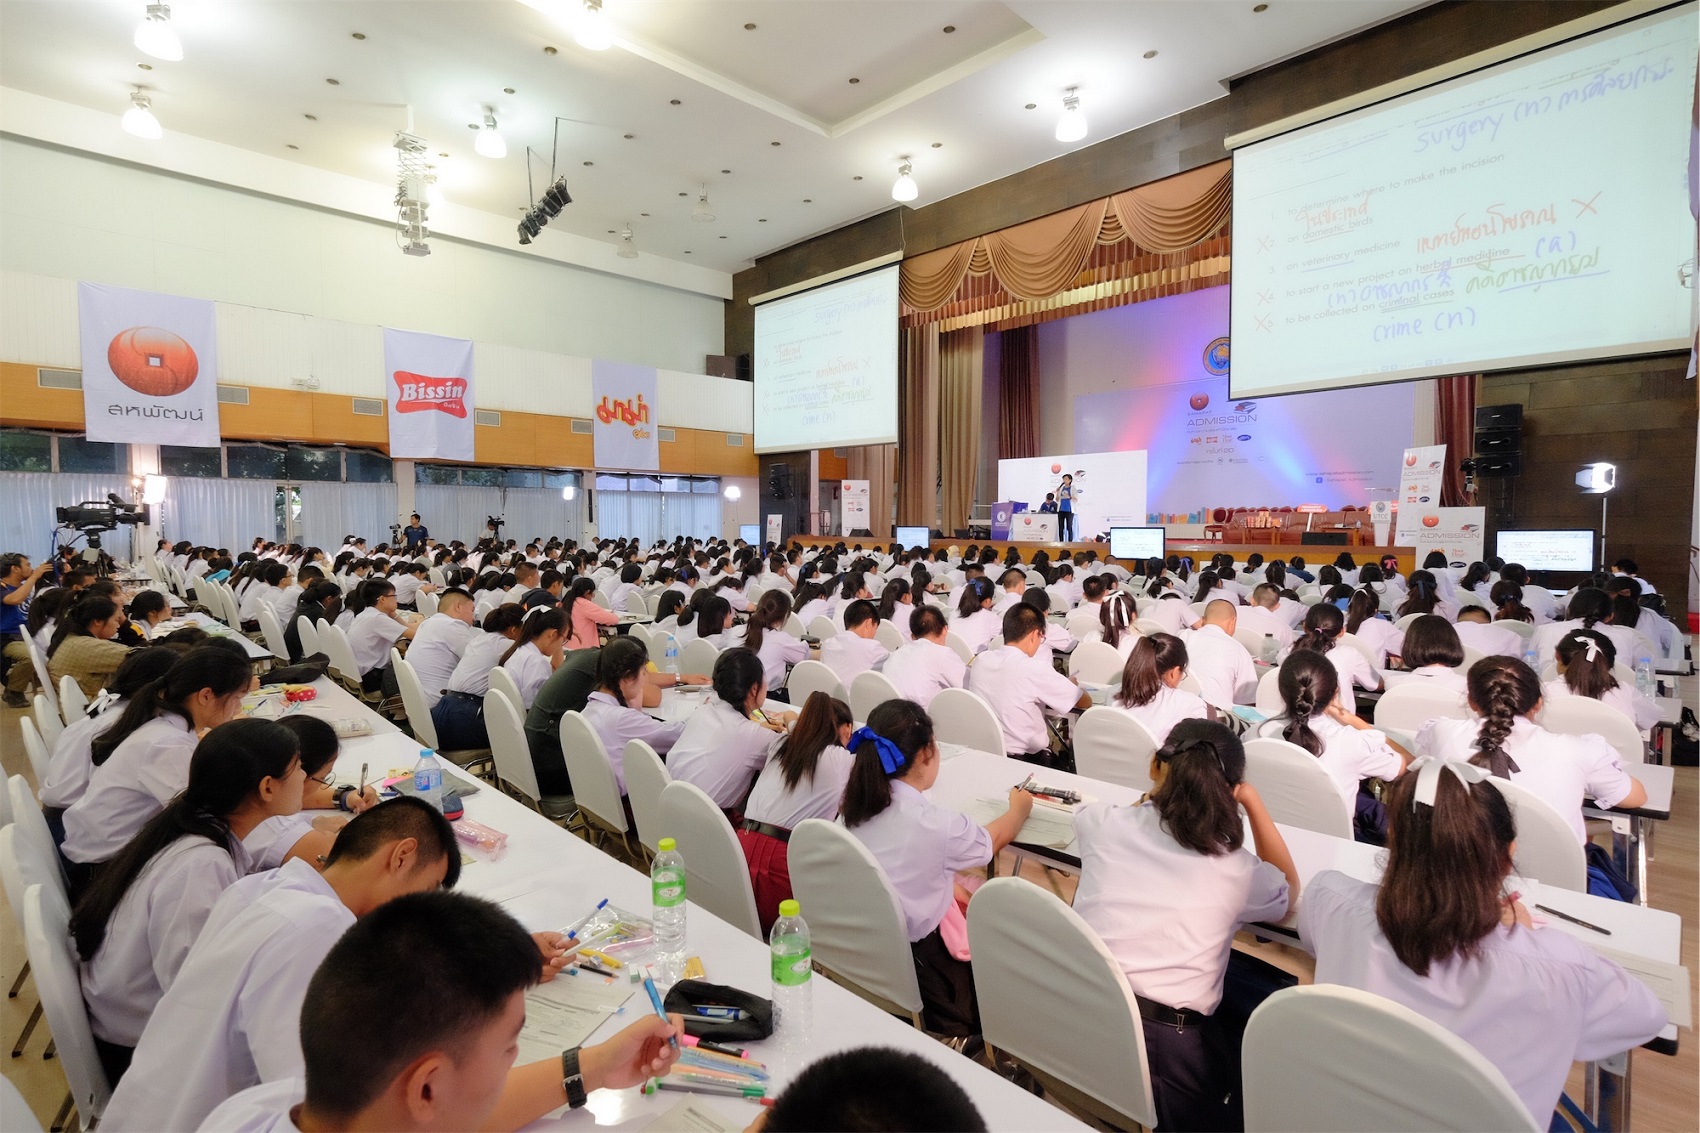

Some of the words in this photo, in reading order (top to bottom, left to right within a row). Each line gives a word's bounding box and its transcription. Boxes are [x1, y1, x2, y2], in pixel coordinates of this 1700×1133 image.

[1414, 113, 1504, 152] surgery
[1300, 195, 1349, 211] determine
[1352, 185, 1386, 199] where
[1389, 181, 1401, 191] to
[1404, 172, 1435, 186] make
[1439, 166, 1457, 177] the
[1461, 154, 1505, 171] incision
[1287, 235, 1299, 243] on
[1302, 223, 1345, 240] domestic
[1349, 216, 1374, 229] birds
[1286, 262, 1299, 270] on
[1301, 252, 1350, 267] veterinary
[1354, 240, 1401, 256] medicine
[1286, 289, 1296, 297] to
[1298, 284, 1319, 296] start
[1333, 279, 1354, 289] new
[1358, 270, 1394, 286] project
[1398, 266, 1412, 276] on
[1456, 248, 1510, 265] medicine
[1285, 317, 1295, 325] to
[1298, 313, 1311, 323] be
[1314, 305, 1359, 320] collected
[1362, 303, 1375, 312] on
[1379, 293, 1420, 309] criminal
[1423, 289, 1455, 301] cases
[1374, 316, 1423, 342] crime
[1434, 306, 1476, 331] (n)
[401, 381, 463, 401] Bissin
[108, 404, 203, 421] สหพัฒน์
[1187, 414, 1257, 427] ADMISSION
[1403, 469, 1441, 477] ADMISSION
